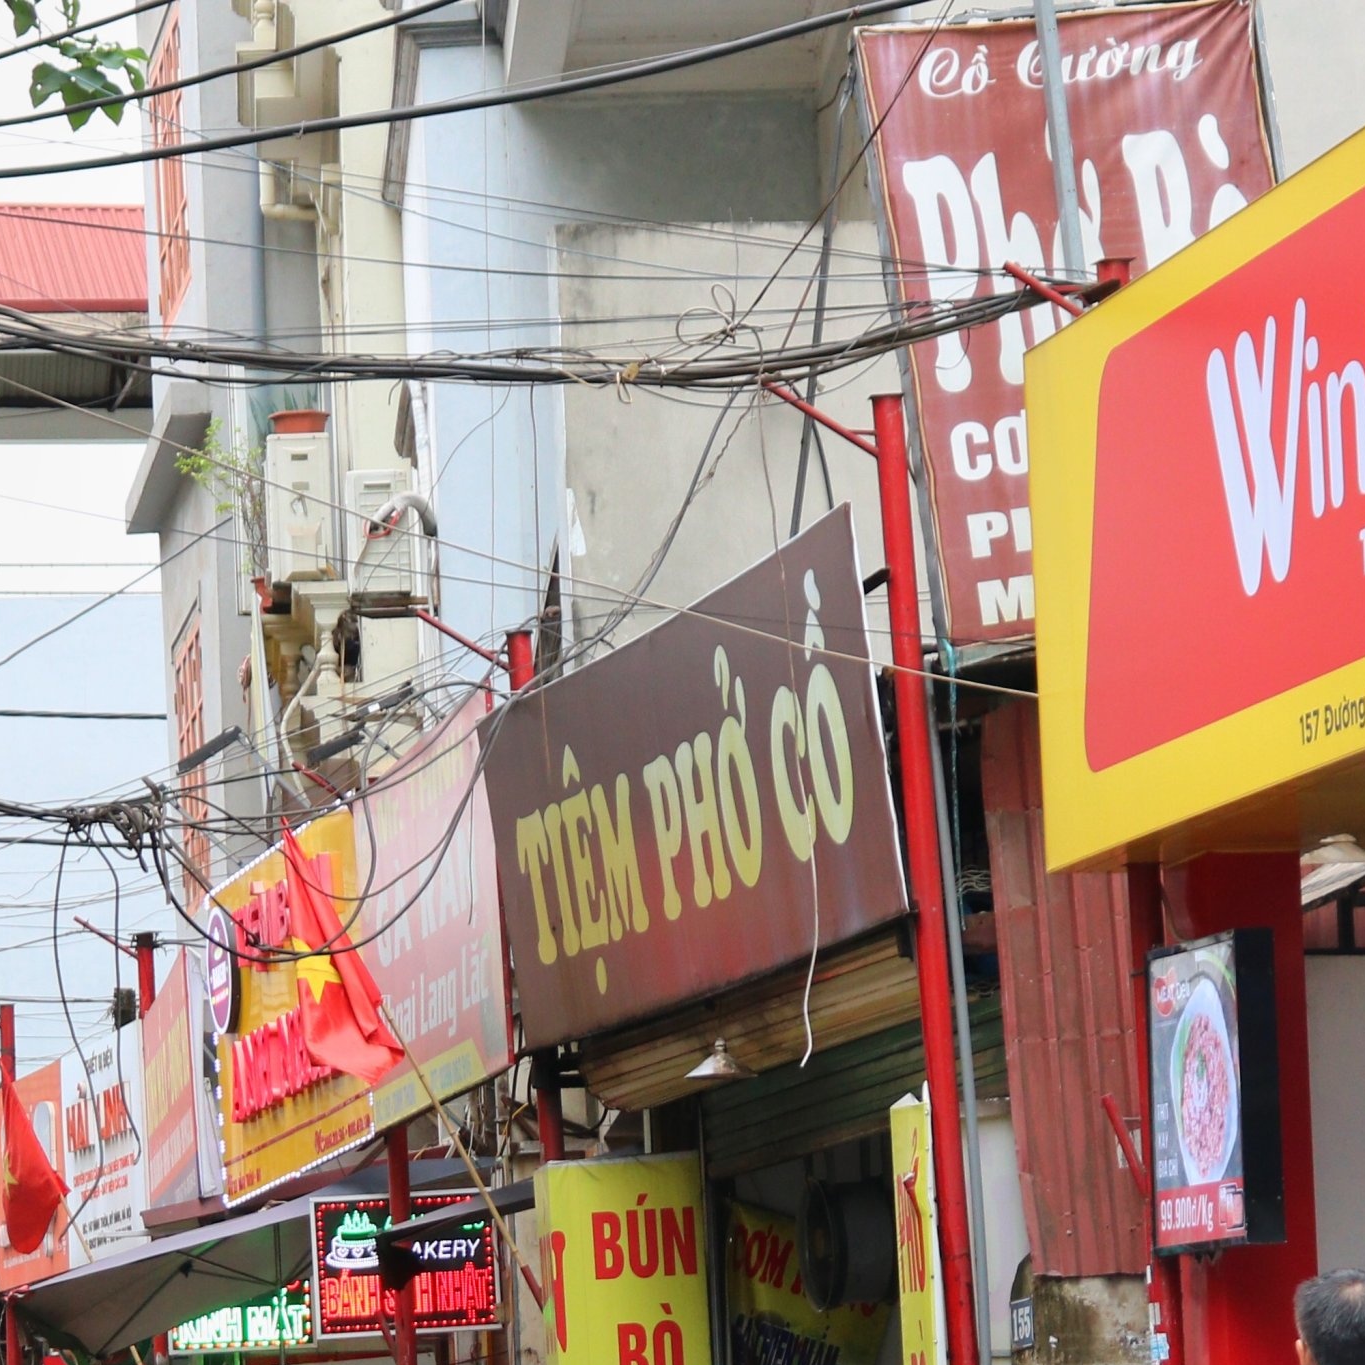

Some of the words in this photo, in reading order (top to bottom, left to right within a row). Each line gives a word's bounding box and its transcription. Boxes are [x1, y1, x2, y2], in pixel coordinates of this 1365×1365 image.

[918, 44, 996, 98] Cồ
[1299, 709, 1320, 746] 157
[516, 744, 649, 995] TIỆM
[642, 644, 763, 920] PHỞ
[770, 567, 855, 863] CỔ
[66, 1082, 96, 1153] HẢI
[411, 1238, 481, 1261] AKERY
[591, 1193, 698, 1281] BÚN
[1012, 1306, 1032, 1342] 155
